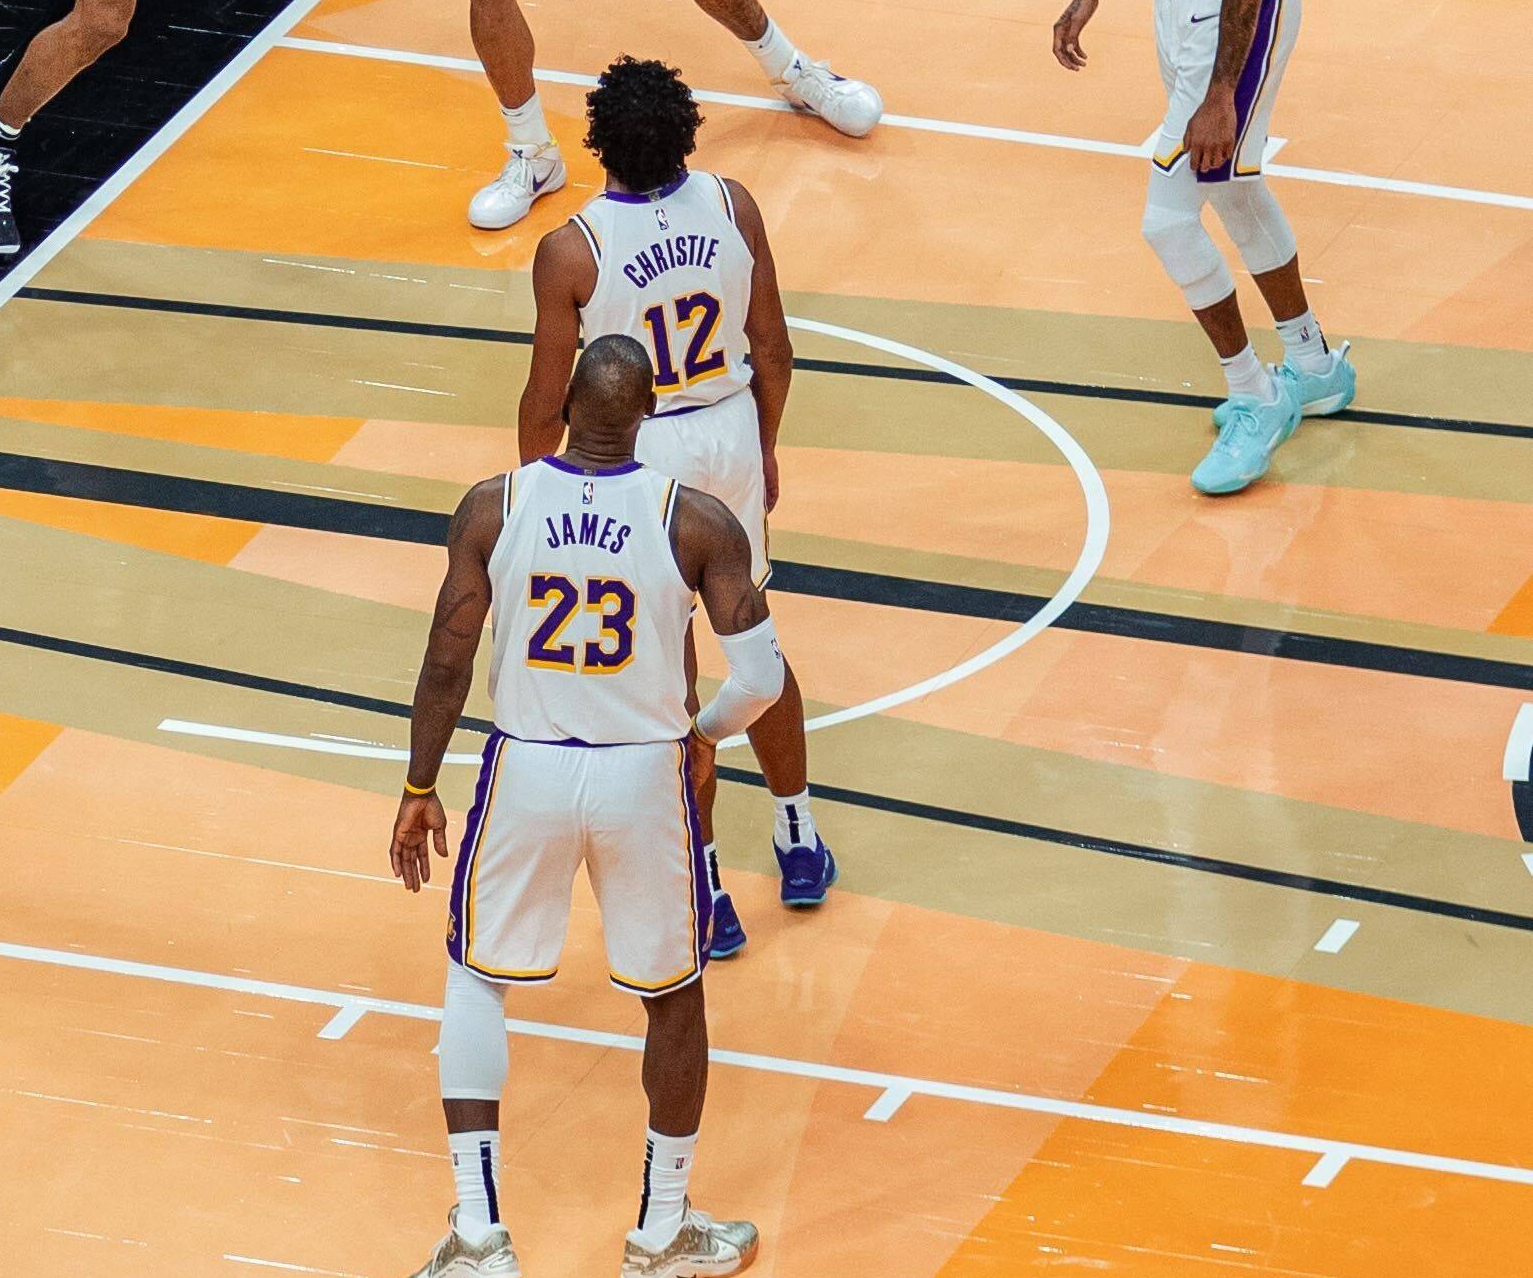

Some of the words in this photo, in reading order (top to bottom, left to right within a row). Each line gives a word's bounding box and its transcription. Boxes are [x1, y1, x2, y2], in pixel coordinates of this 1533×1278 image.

[623, 234, 720, 289] CHRISTIE
[641, 289, 730, 394] 12
[546, 512, 632, 555] JAMES
[525, 571, 639, 676] 23
